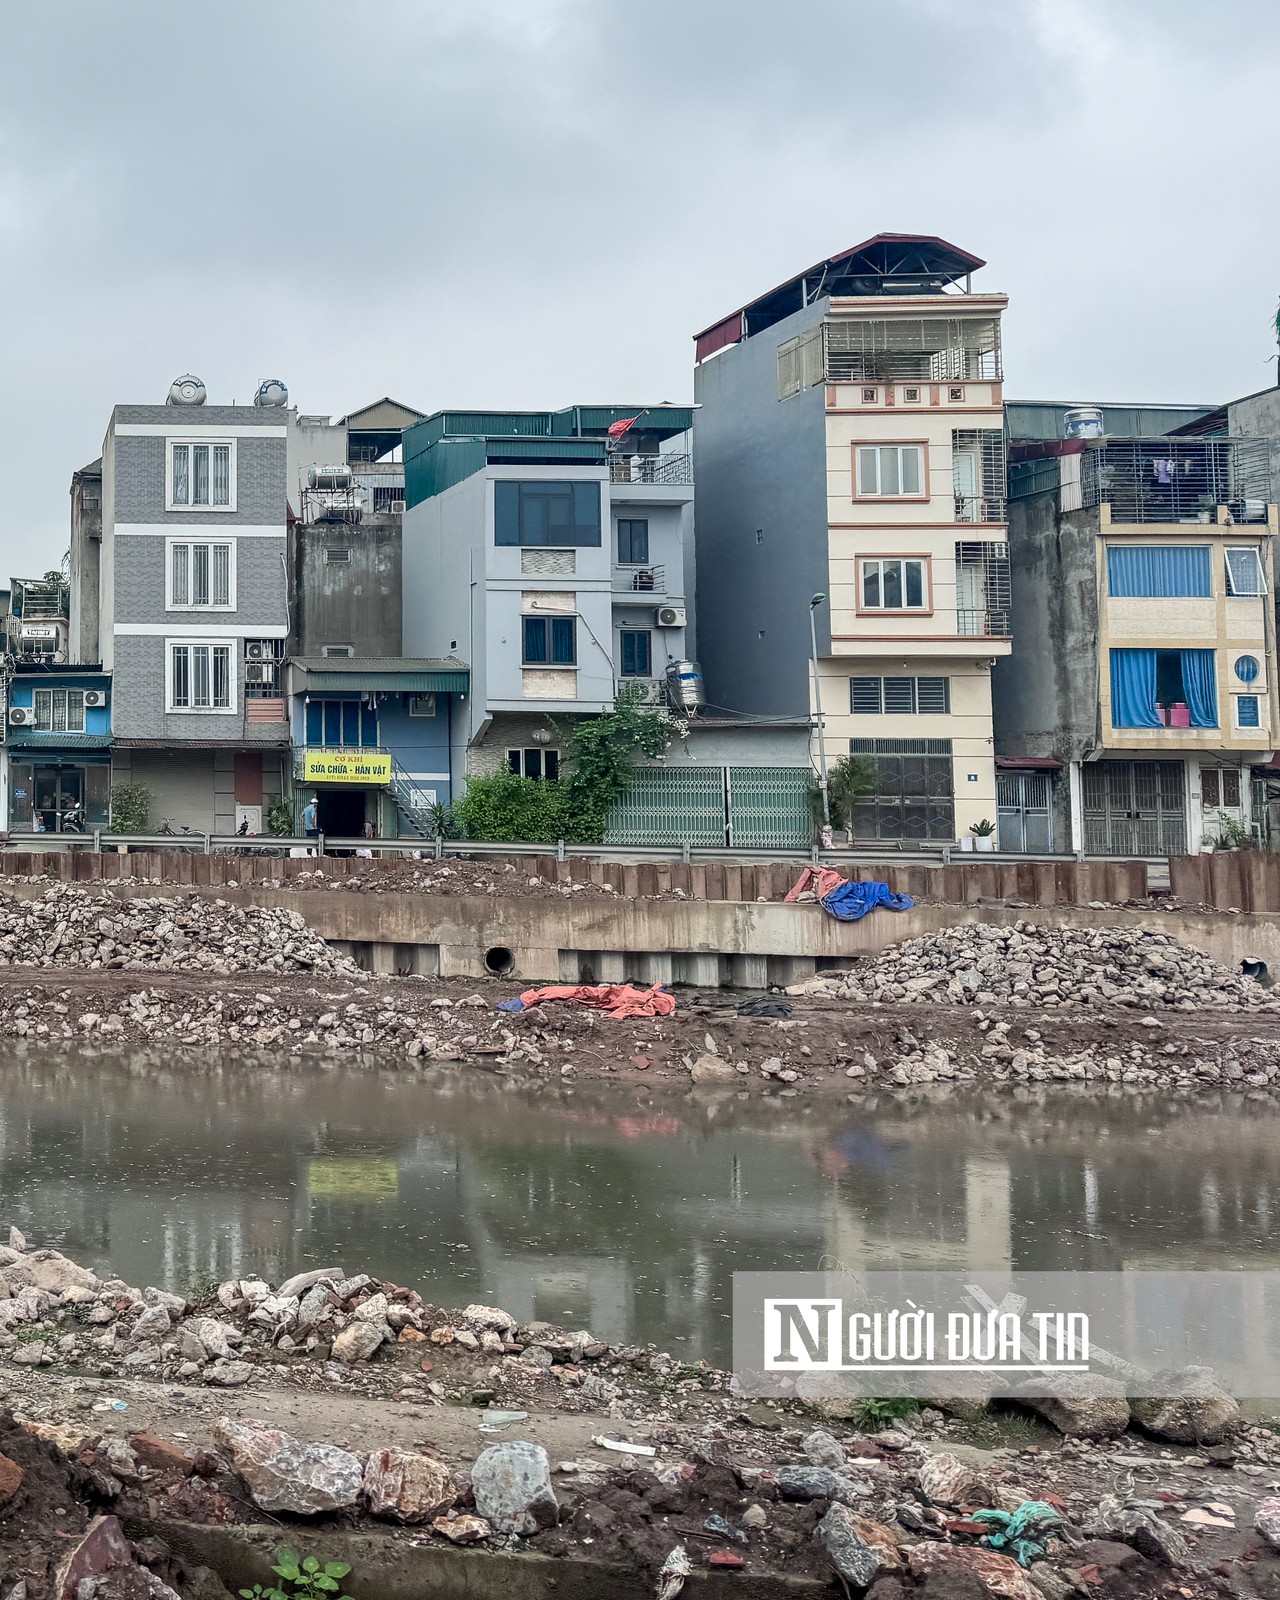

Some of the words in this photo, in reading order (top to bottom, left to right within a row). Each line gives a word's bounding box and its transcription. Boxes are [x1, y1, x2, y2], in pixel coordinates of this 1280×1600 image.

[310, 761, 326, 774] SỬA
[328, 763, 348, 774] CHỮA
[355, 764, 370, 775] HÀN
